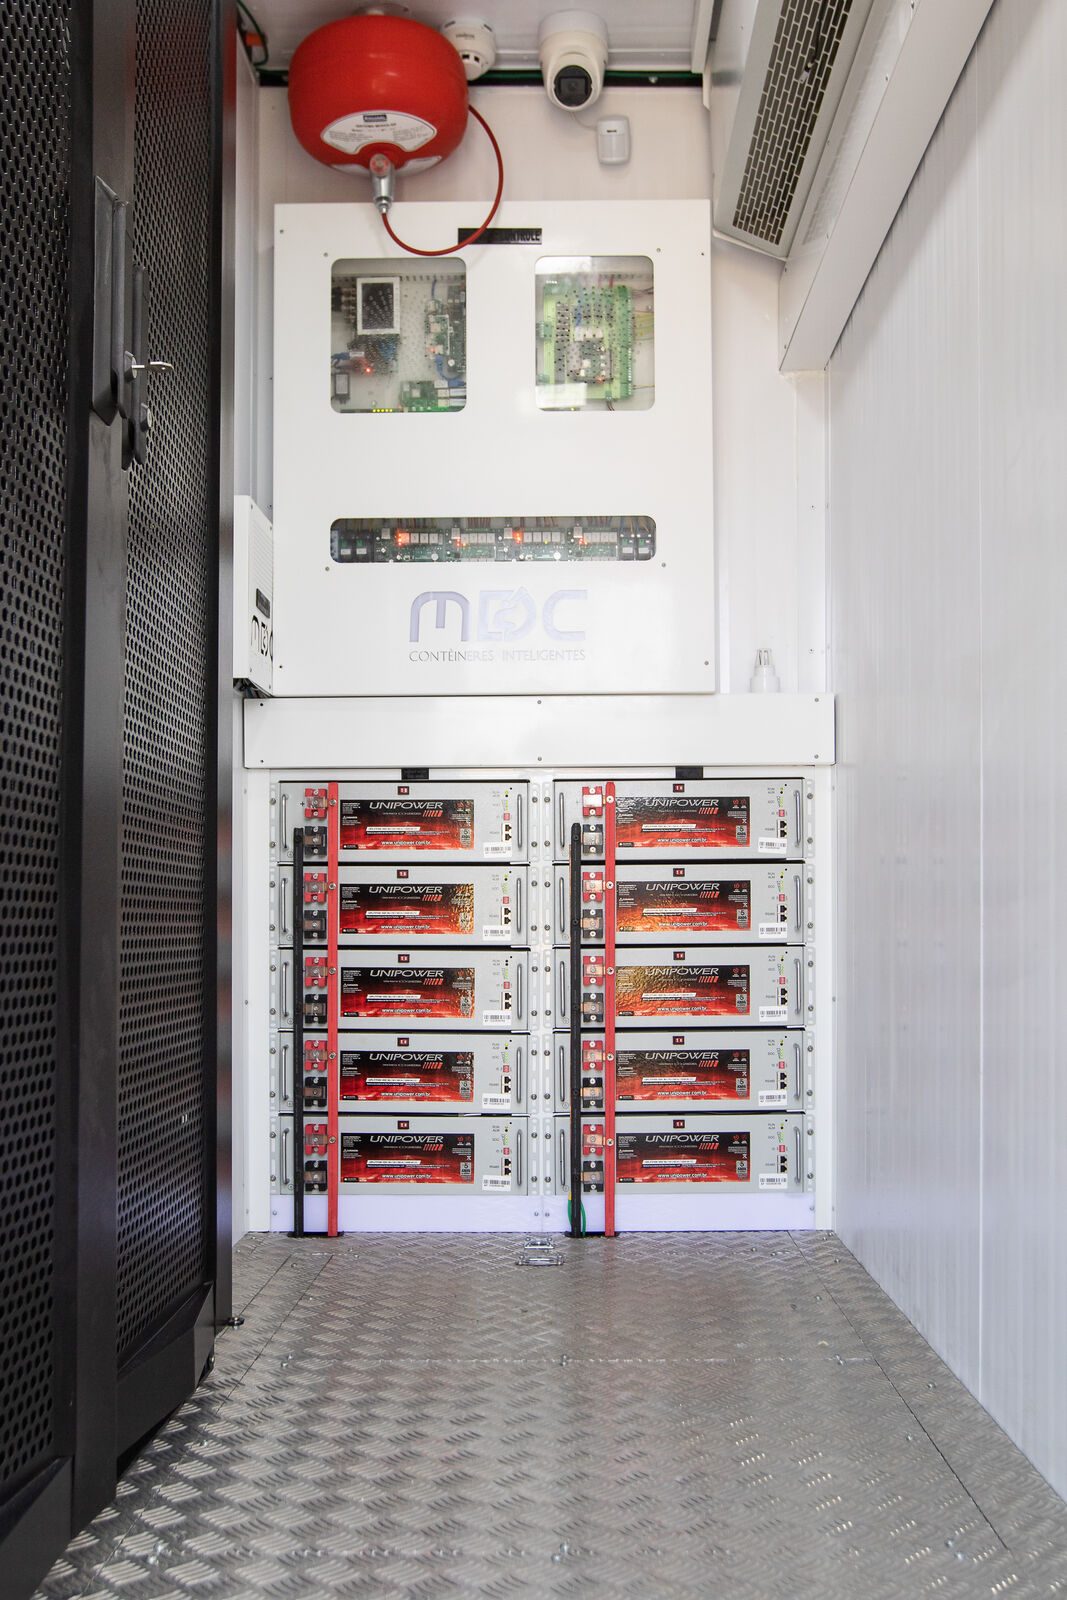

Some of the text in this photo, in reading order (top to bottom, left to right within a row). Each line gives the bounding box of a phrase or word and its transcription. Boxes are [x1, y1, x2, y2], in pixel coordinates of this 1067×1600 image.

[369, 801, 444, 810] UNIPOWER
[368, 885, 443, 894] UNIPOWER
[645, 883, 720, 891] UNIPOWER
[369, 969, 444, 977] UNIPOWER
[369, 1053, 443, 1061] UNIPOWER
[645, 1051, 719, 1060] UNIPOWER
[369, 1135, 444, 1143] UNIPOWER
[645, 1134, 719, 1143] UNIPOWER
